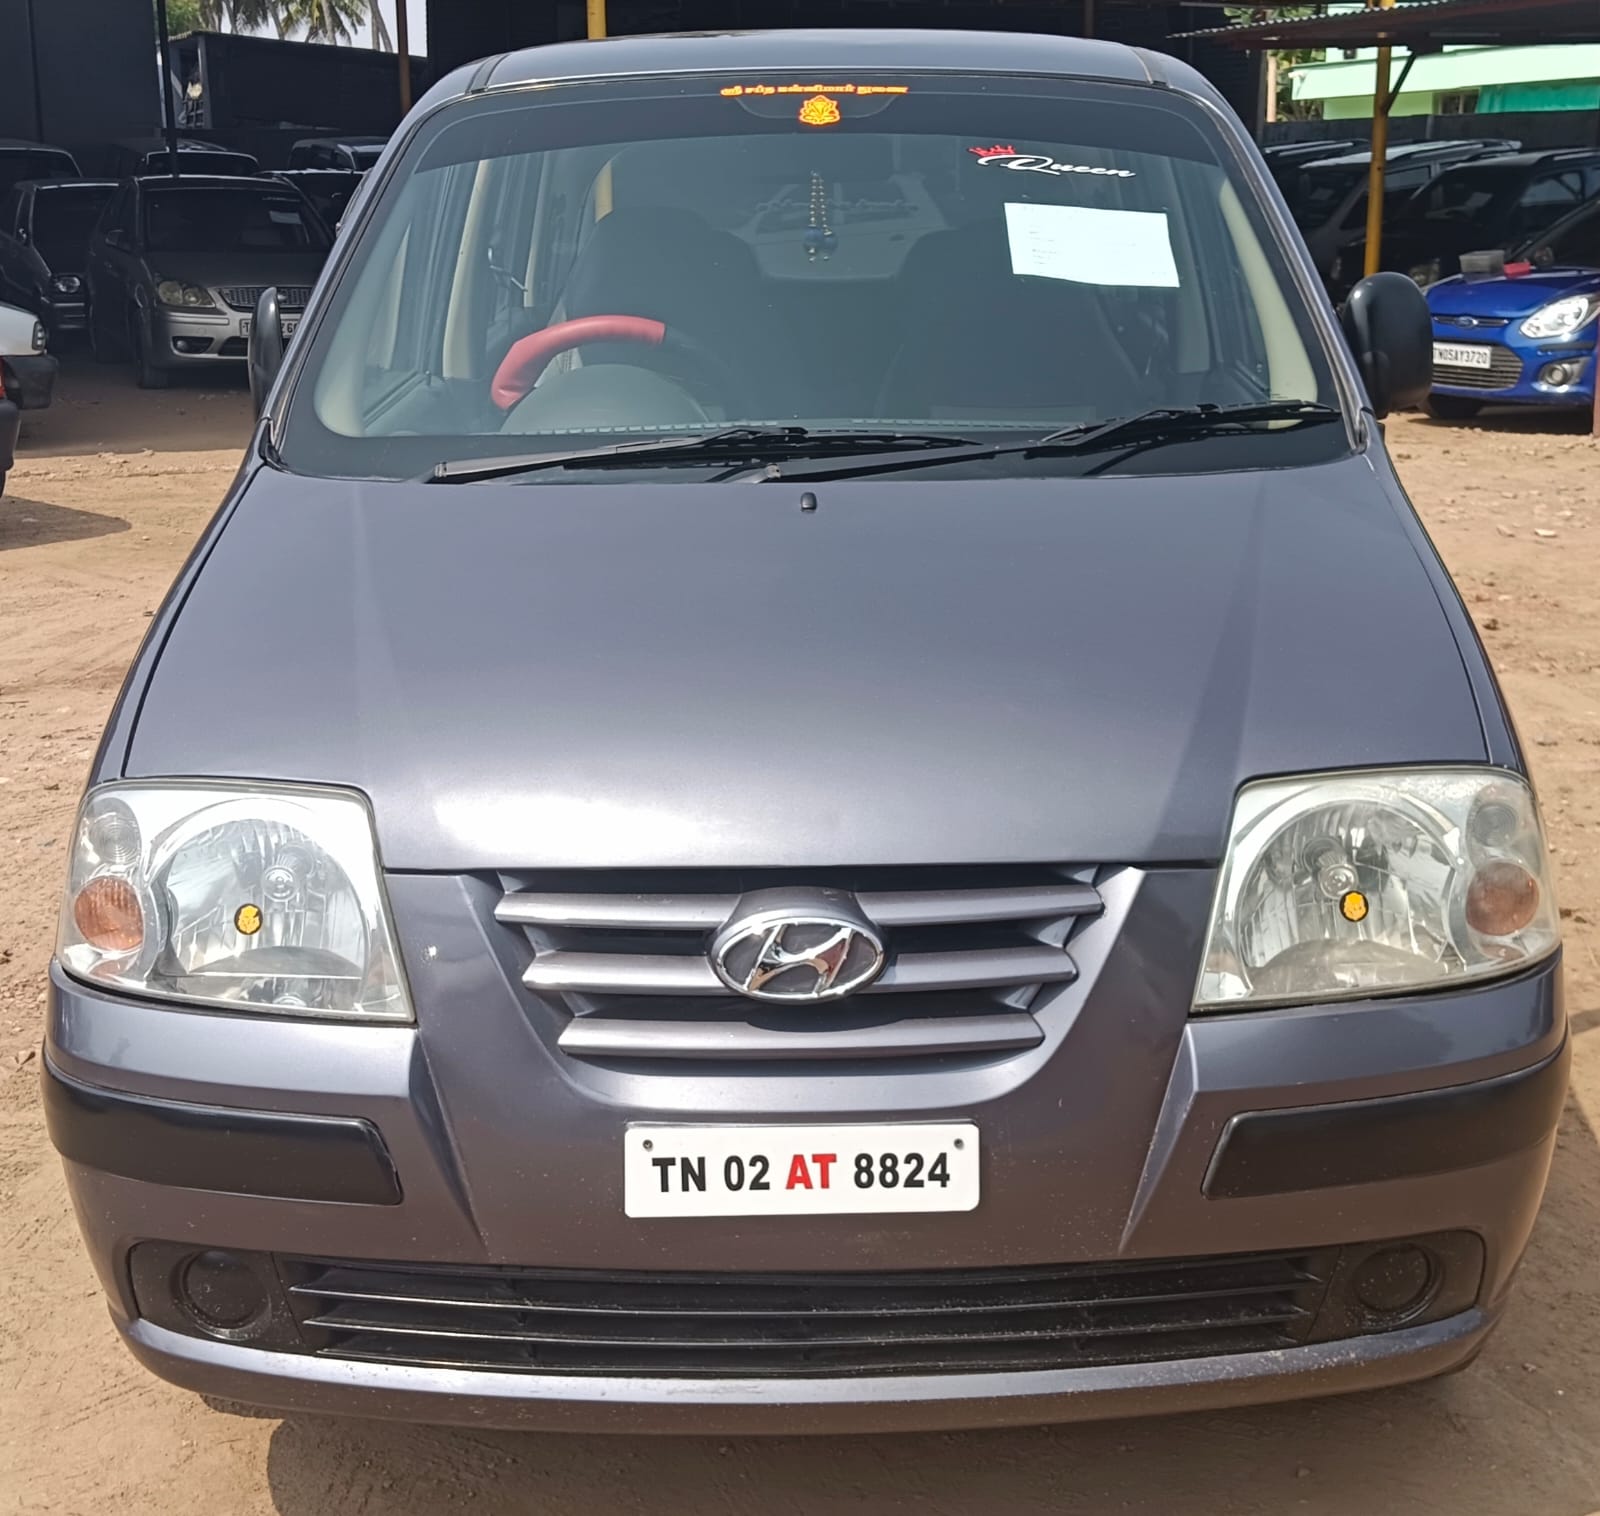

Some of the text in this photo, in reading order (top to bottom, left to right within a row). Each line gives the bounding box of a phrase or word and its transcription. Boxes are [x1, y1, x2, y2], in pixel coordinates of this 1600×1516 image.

[977, 154, 1136, 178] Queen
[652, 1152, 951, 1193] TN 02 AT 8824
